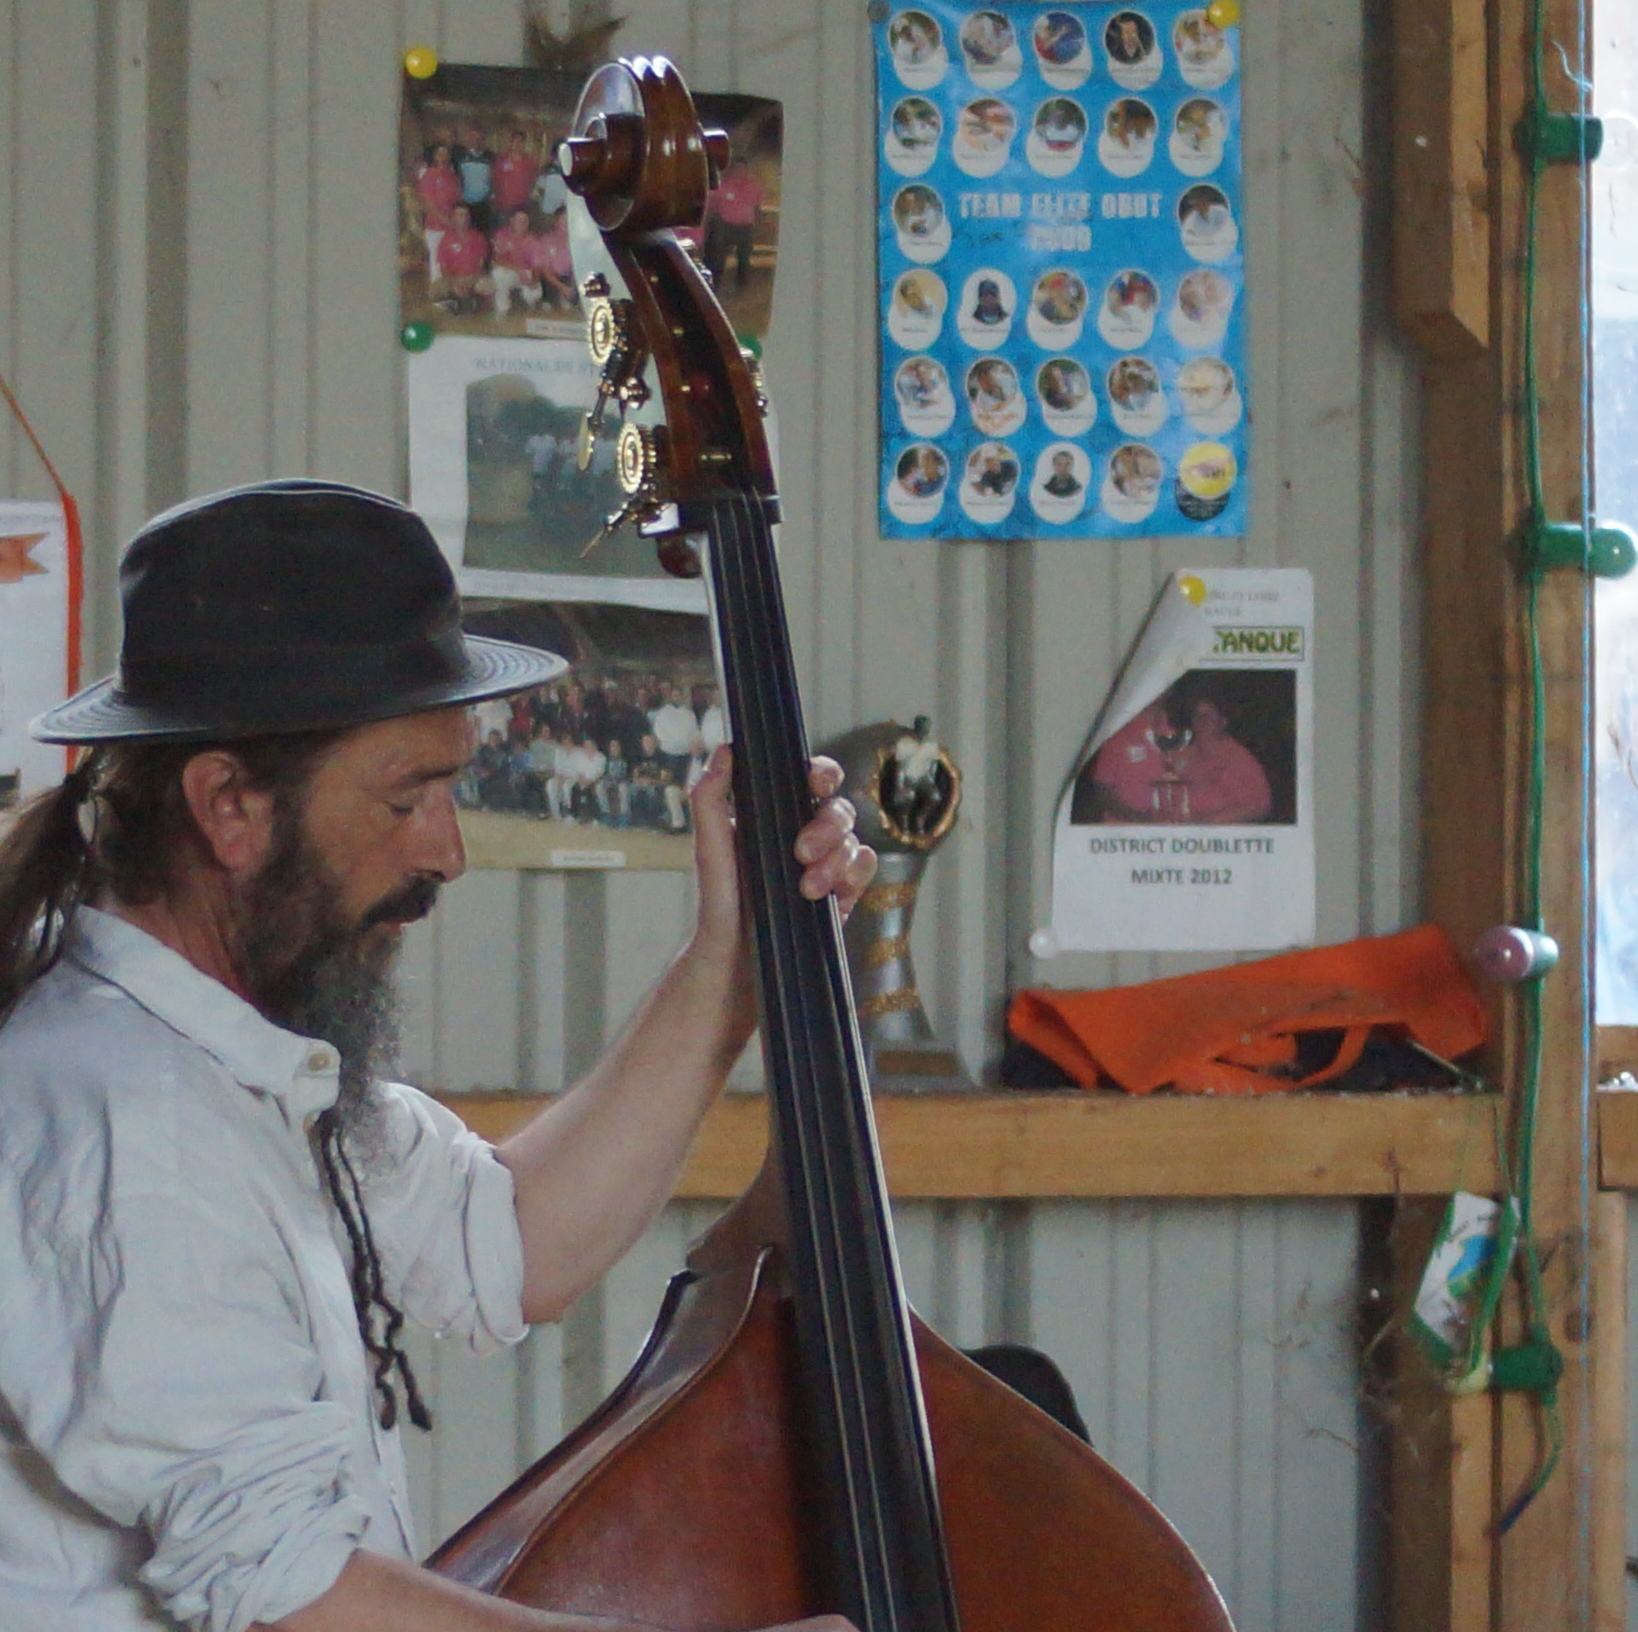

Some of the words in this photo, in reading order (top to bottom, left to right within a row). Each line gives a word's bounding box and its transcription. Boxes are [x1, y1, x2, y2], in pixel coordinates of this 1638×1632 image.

[960, 191, 1021, 218] TEAM
[1090, 838, 1166, 854] DISTRICT
[1171, 838, 1275, 854] DOUBLETTE
[1132, 868, 1183, 885] MIXTE
[1191, 868, 1232, 885] 2012
